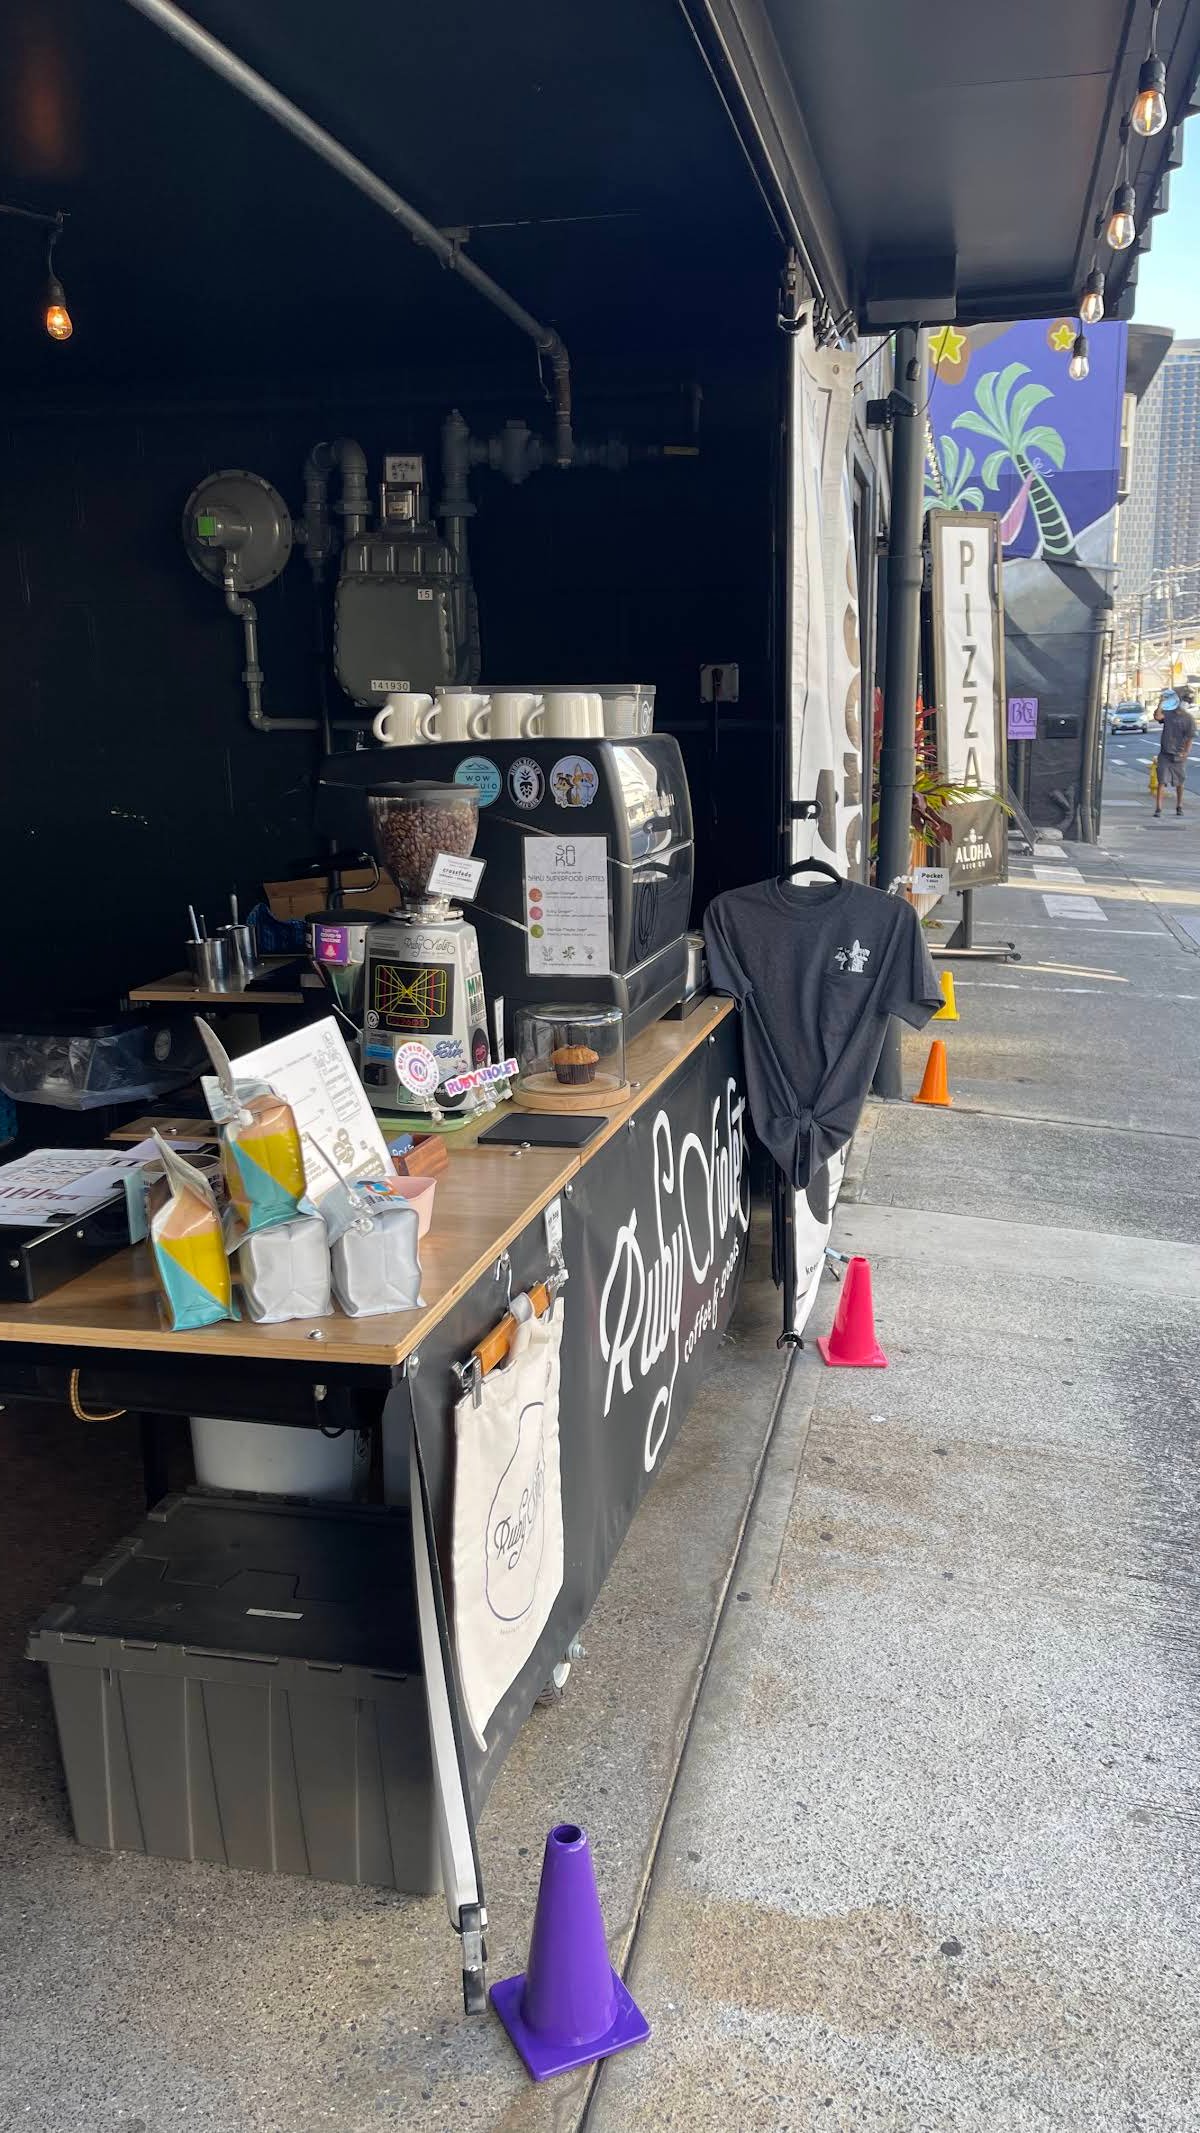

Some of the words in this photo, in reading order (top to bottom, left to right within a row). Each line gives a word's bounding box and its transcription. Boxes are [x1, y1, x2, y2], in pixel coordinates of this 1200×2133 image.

[418, 590, 430, 599] 15
[372, 681, 409, 691] 141930
[959, 540, 981, 791] PIZZA
[955, 842, 992, 864] ALOHA
[601, 1110, 683, 1472] Ruby
[684, 1300, 712, 1363] coffee
